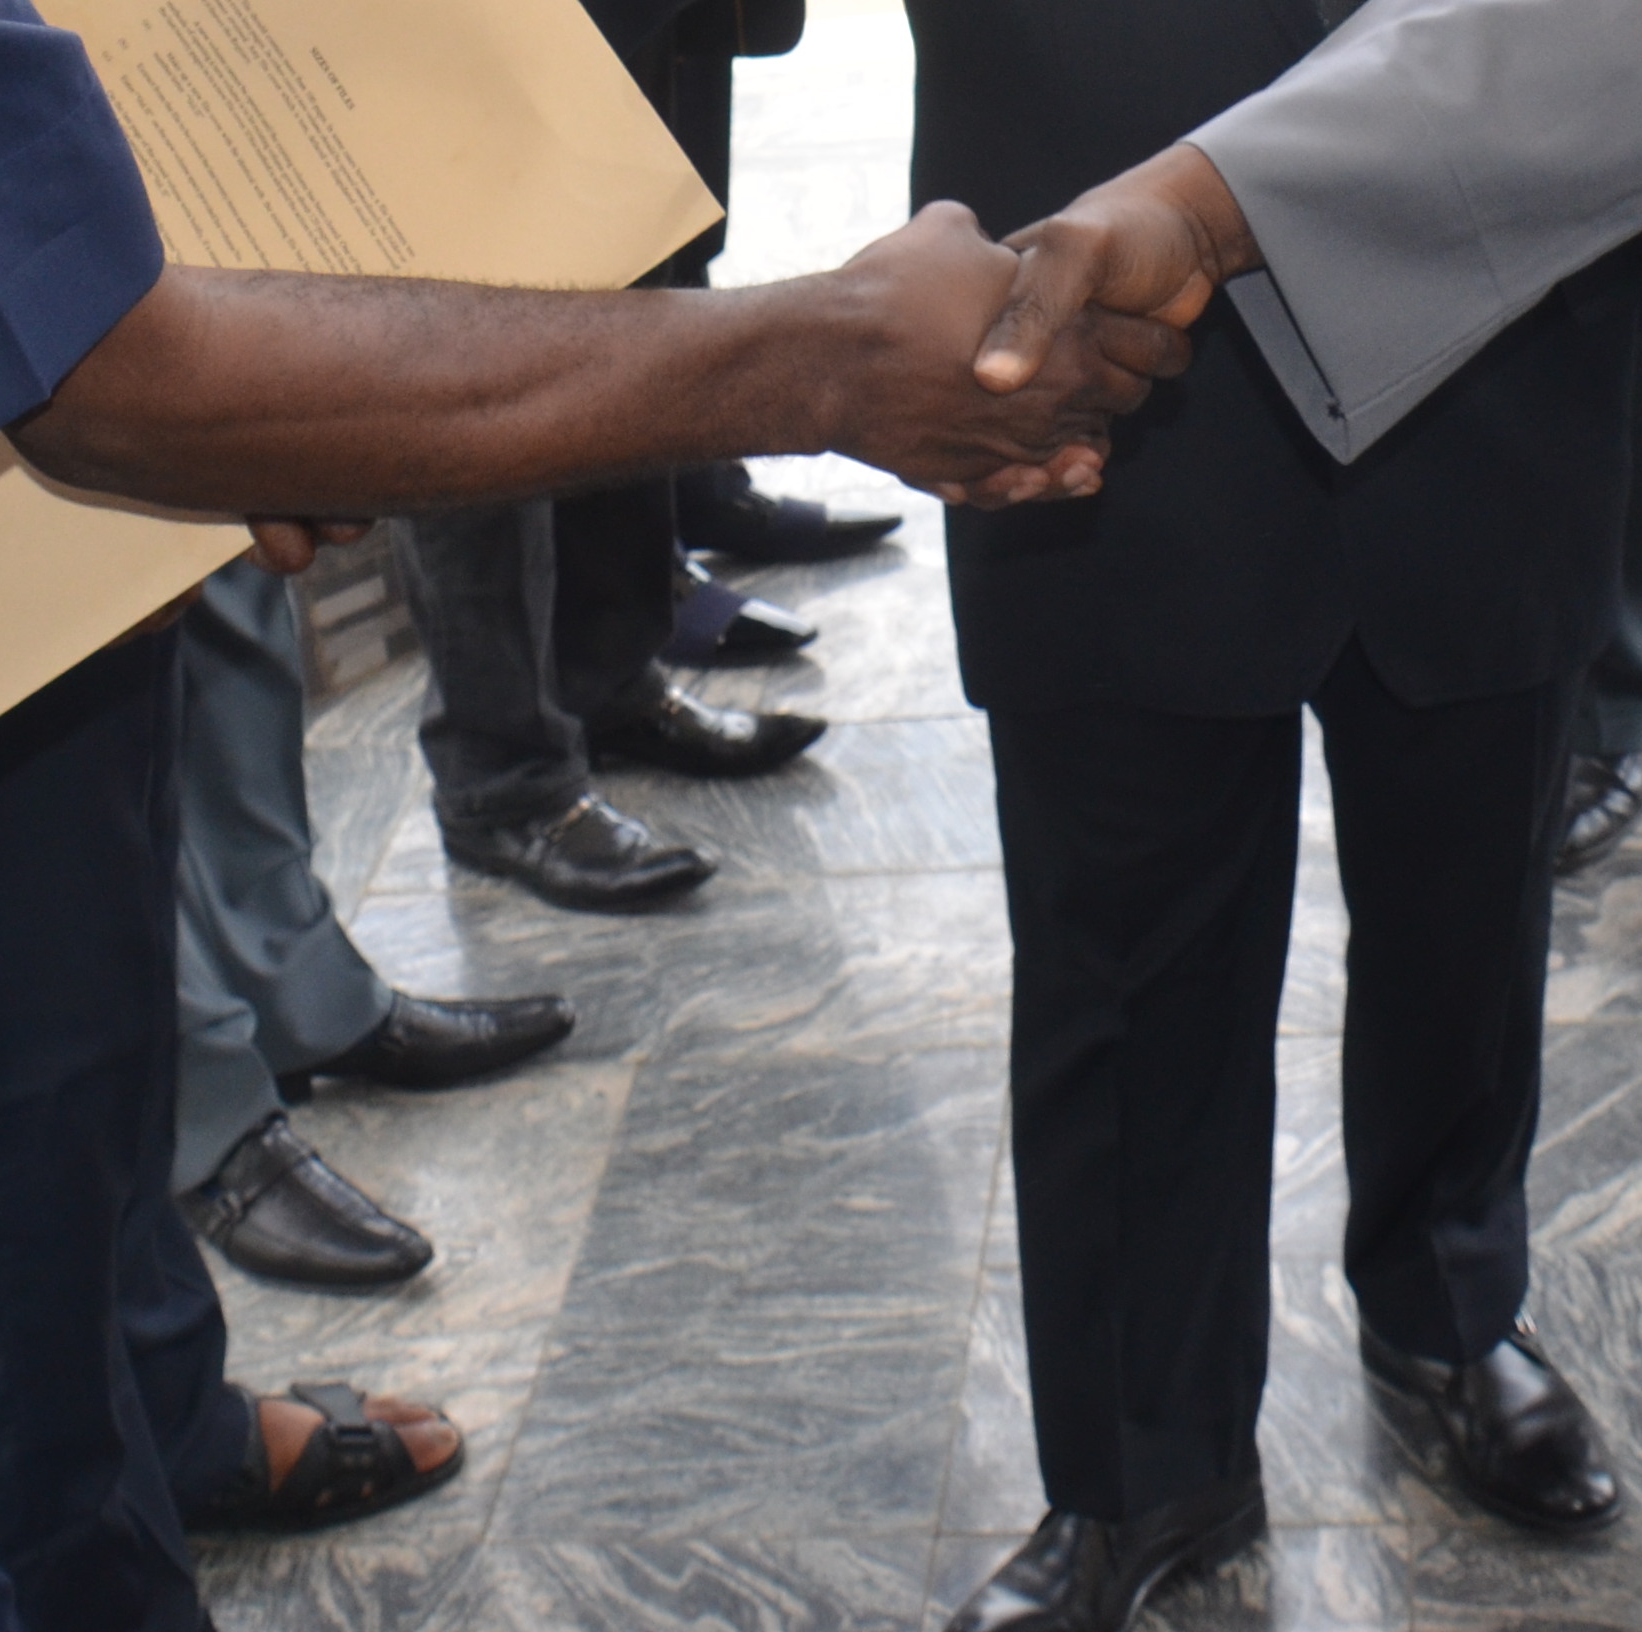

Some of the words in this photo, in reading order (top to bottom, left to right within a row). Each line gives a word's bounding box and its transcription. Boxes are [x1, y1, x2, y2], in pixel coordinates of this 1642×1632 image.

[309, 46, 330, 73] SIZES
[326, 71, 338, 84] OF
[335, 84, 355, 110] FILES
